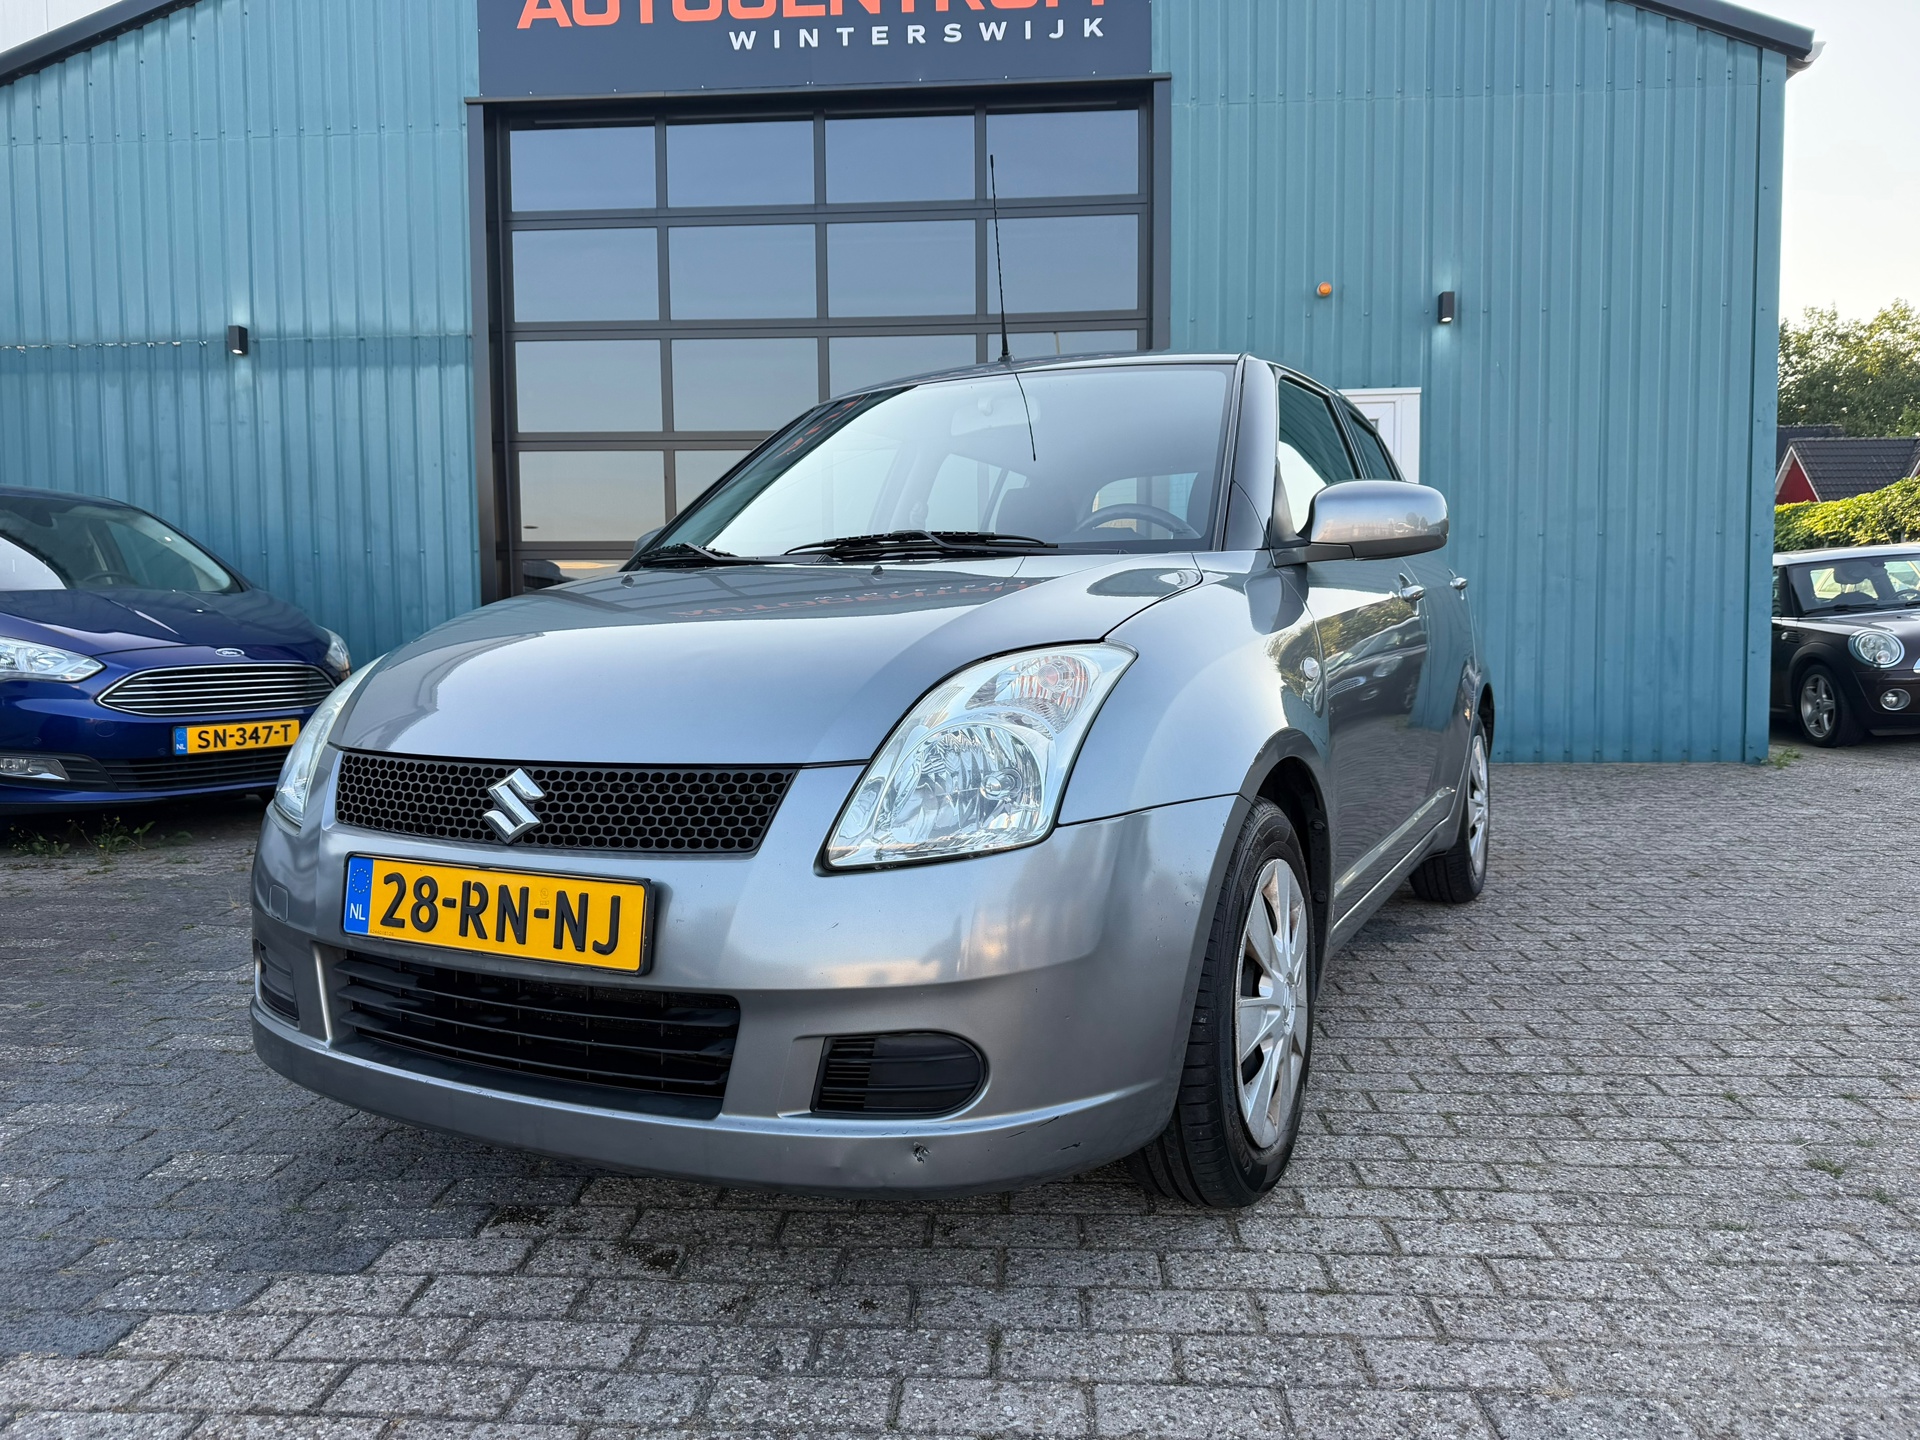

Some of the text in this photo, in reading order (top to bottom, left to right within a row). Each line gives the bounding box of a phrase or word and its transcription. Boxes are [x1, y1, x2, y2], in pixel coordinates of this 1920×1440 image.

[729, 18, 1104, 50] WINTERSWIJK
[198, 724, 291, 749] SN-347-T
[349, 903, 366, 920] NL
[380, 872, 621, 955] 28-RN-NJ
